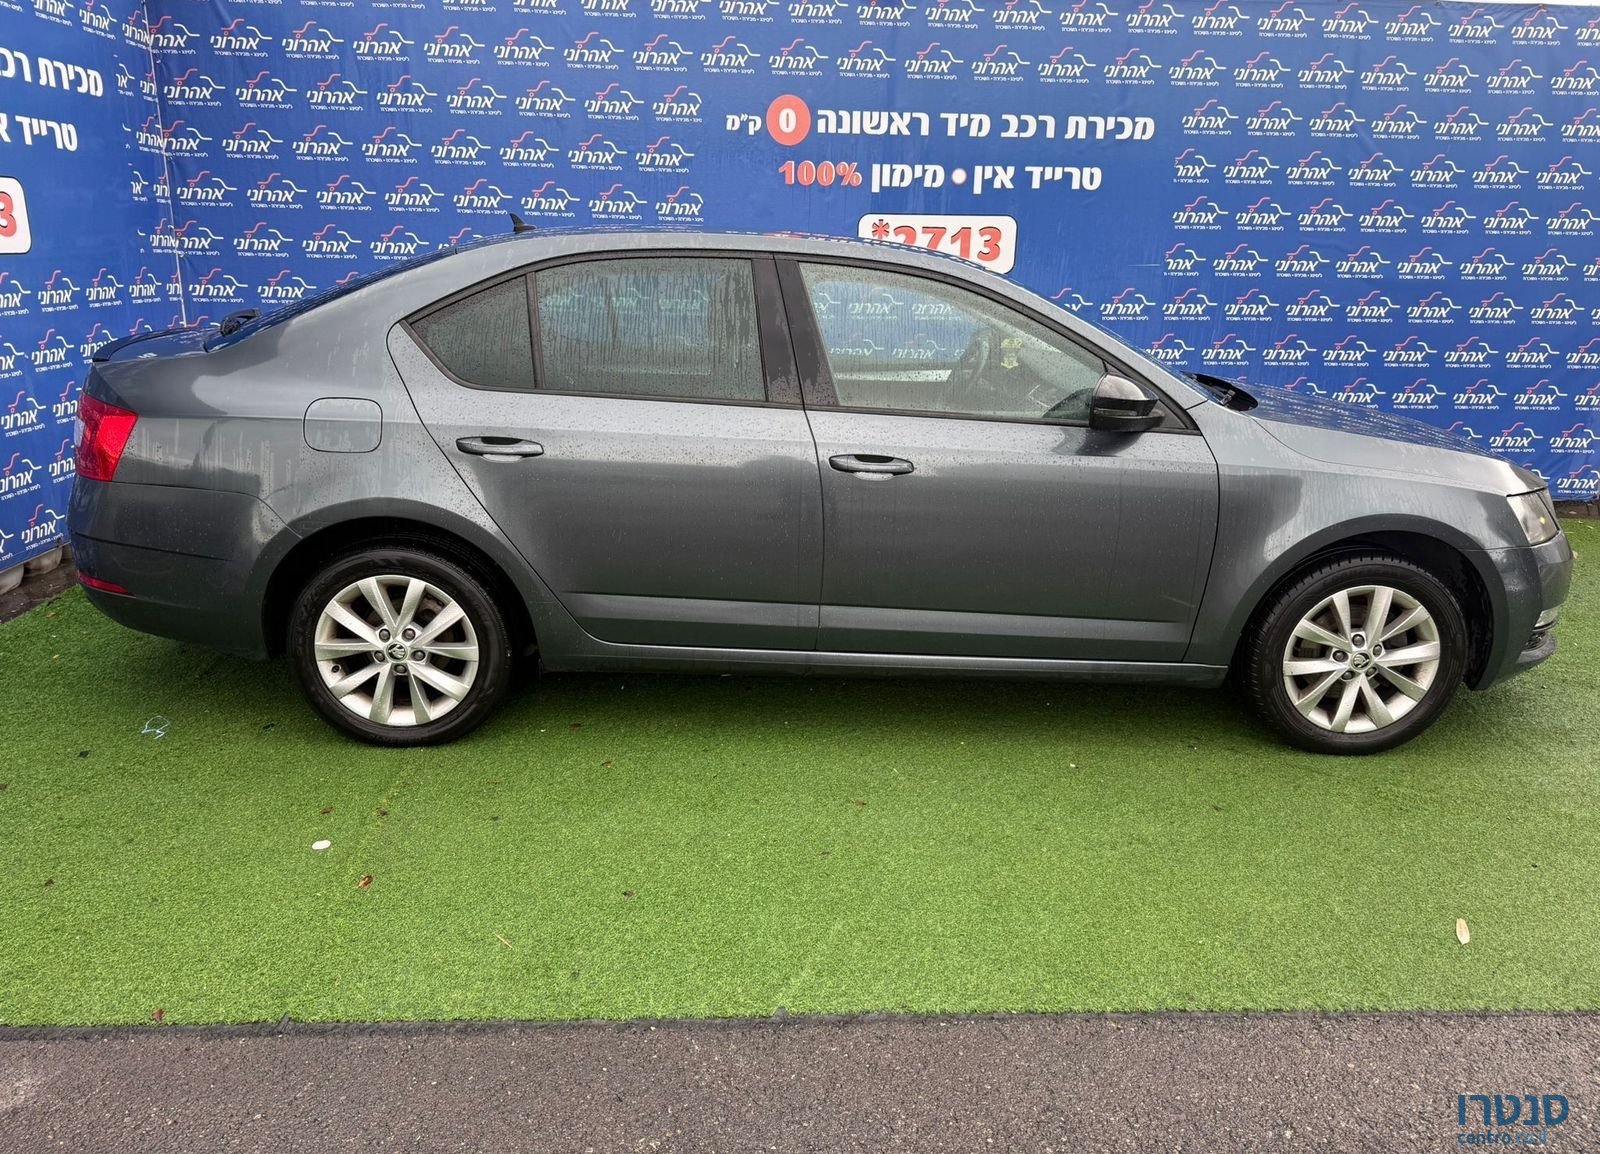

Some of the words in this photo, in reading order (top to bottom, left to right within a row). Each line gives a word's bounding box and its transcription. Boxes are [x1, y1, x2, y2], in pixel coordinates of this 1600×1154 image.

[649, 1, 700, 13] אהרוני
[788, 4, 837, 17] אהרוני
[857, 5, 904, 20] אהרוני
[79, 8, 110, 30] אהרוני
[925, 7, 972, 22] אהרוני
[993, 11, 1040, 24] אהרוני
[1059, 13, 1107, 26] אהרוני
[1126, 14, 1173, 27] אהרוני
[1191, 16, 1239, 29] אהרוני
[1257, 18, 1303, 31] אהרוני
[1322, 20, 1367, 32] אהרוני
[1385, 22, 1430, 35] אהרוני
[1448, 25, 1493, 37] אהרוני
[1511, 26, 1556, 39] אהרוני
[210, 35, 260, 50] אהרוני
[281, 38, 332, 53] אהרוני
[353, 40, 402, 55] אהרוני
[424, 42, 472, 58] אהרוני
[494, 45, 542, 60] אהרוני
[563, 48, 612, 63] אהרוני
[632, 51, 680, 65] אהרוני
[701, 52, 748, 67] אהרוני
[769, 54, 816, 70] אהרוני
[836, 56, 883, 72] אהרוני
[0, 48, 32, 82] רכ
[905, 60, 952, 73] אהרוני
[971, 62, 1019, 75] אהרוני
[1037, 64, 1085, 76] אהרוני
[1104, 65, 1150, 78] אהרוני
[38, 57, 104, 97] מכירת
[1169, 67, 1215, 80] אהרוני
[1234, 68, 1279, 81] אהרוני
[1298, 70, 1343, 82] אהרוני
[1360, 72, 1406, 85] אהרוני
[1424, 74, 1468, 87] אהרוני
[1486, 76, 1530, 88] אהרוני
[1551, 77, 1594, 89] אהרוני
[163, 86, 214, 100] אהרוני
[235, 88, 285, 102] אהרוני
[306, 90, 355, 105] אהרוני
[376, 92, 425, 106] אהרוני
[446, 94, 494, 109] אהרוני
[515, 97, 564, 111] אהרוני
[584, 100, 632, 114] אהרוני
[652, 102, 699, 116] אהרוני
[778, 108, 796, 133] 0
[818, 110, 930, 136] ראשונה
[940, 112, 991, 138] מיד
[1000, 114, 1055, 138] רכב
[1182, 116, 1227, 128] אהרוני
[1246, 118, 1291, 130] אהרוני
[1309, 119, 1354, 131] אהרוני
[1372, 120, 1416, 133] אהרוני
[15, 115, 78, 152] טרייד
[1064, 115, 1154, 140] מכירת
[1434, 122, 1478, 135] אהרוני
[1496, 123, 1542, 135] אהרוני
[136, 131, 163, 148] אהרוני
[222, 138, 270, 153] אהרוני
[292, 141, 341, 155] אהרוני
[362, 143, 410, 157] אהרוני
[430, 145, 479, 159] אהרוני
[500, 147, 546, 161] אהרוני
[568, 150, 614, 164] אהרוני
[635, 152, 682, 167] אהרוני
[778, 160, 862, 186] 100%
[872, 164, 945, 193] מימון
[1025, 166, 1102, 190] טרייד
[1223, 166, 1268, 178] אהרוני
[1286, 167, 1330, 179] אהרוני
[1348, 168, 1392, 181] אהרוני
[1410, 170, 1454, 182] אהרוני
[1472, 171, 1517, 183] אהרוני
[1536, 172, 1580, 184] אהרוני
[973, 166, 1015, 194] אין
[176, 186, 225, 201] אהרוני
[246, 188, 295, 203] אהרוני
[316, 190, 364, 205] אהרוני
[384, 192, 432, 206] אהרוני
[453, 194, 500, 208] אהרוני
[521, 196, 568, 211] אהרוני
[588, 200, 635, 214] אהרוני
[655, 202, 702, 216] אהרוני
[1173, 212, 1217, 224] אהרוני
[1236, 212, 1280, 225] אהרוני
[1298, 214, 1342, 226] אהרוני
[1359, 216, 1403, 227] אהרוני
[1421, 216, 1465, 228] אהרוני
[1484, 217, 1528, 228] אהרוני
[1546, 218, 1590, 230] אהרוני
[233, 238, 282, 251] אהרוני
[302, 239, 350, 253] אהרוני
[1213, 260, 1257, 271] אהרוני
[1275, 260, 1319, 272] אהרוני
[1336, 261, 1380, 272] אהרוני
[1397, 262, 1441, 274] אהרוני
[1460, 263, 1504, 274] אהרוני
[1522, 264, 1566, 275] אהרוני
[38, 289, 72, 304] אהרוני
[86, 286, 116, 300] אהרוני
[129, 284, 156, 296] אהרוני
[188, 283, 236, 297] אהרוני
[1100, 303, 1144, 314] אהרוני
[1162, 304, 1206, 315] אהרוני
[1224, 304, 1268, 316] אהרוני
[1286, 304, 1330, 316] אהרוני
[1346, 306, 1390, 317] אהרוני
[1406, 306, 1450, 318] אהרוני
[1468, 307, 1512, 318] אהרוני
[1530, 308, 1573, 319] אהרוני
[32, 347, 65, 365] אהרוני
[1202, 349, 1246, 360] אהרוני
[1262, 349, 1306, 360] אהרוני
[1323, 350, 1365, 361] אהרוני
[1382, 351, 1426, 362] אהרוני
[1444, 351, 1488, 362] אהרוני
[1506, 352, 1548, 363] אהרוני
[1392, 393, 1435, 404] אהרוני
[1453, 393, 1496, 404] אהרוני
[1514, 394, 1556, 405] אהרוני
[53, 400, 78, 417] הרוני
[1, 409, 38, 430] אהרוני
[1489, 436, 1532, 447] אהרוני
[1549, 437, 1592, 448] אהרוני
[1556, 476, 1598, 490] אהרוני
[22, 520, 56, 544] אהרוני
